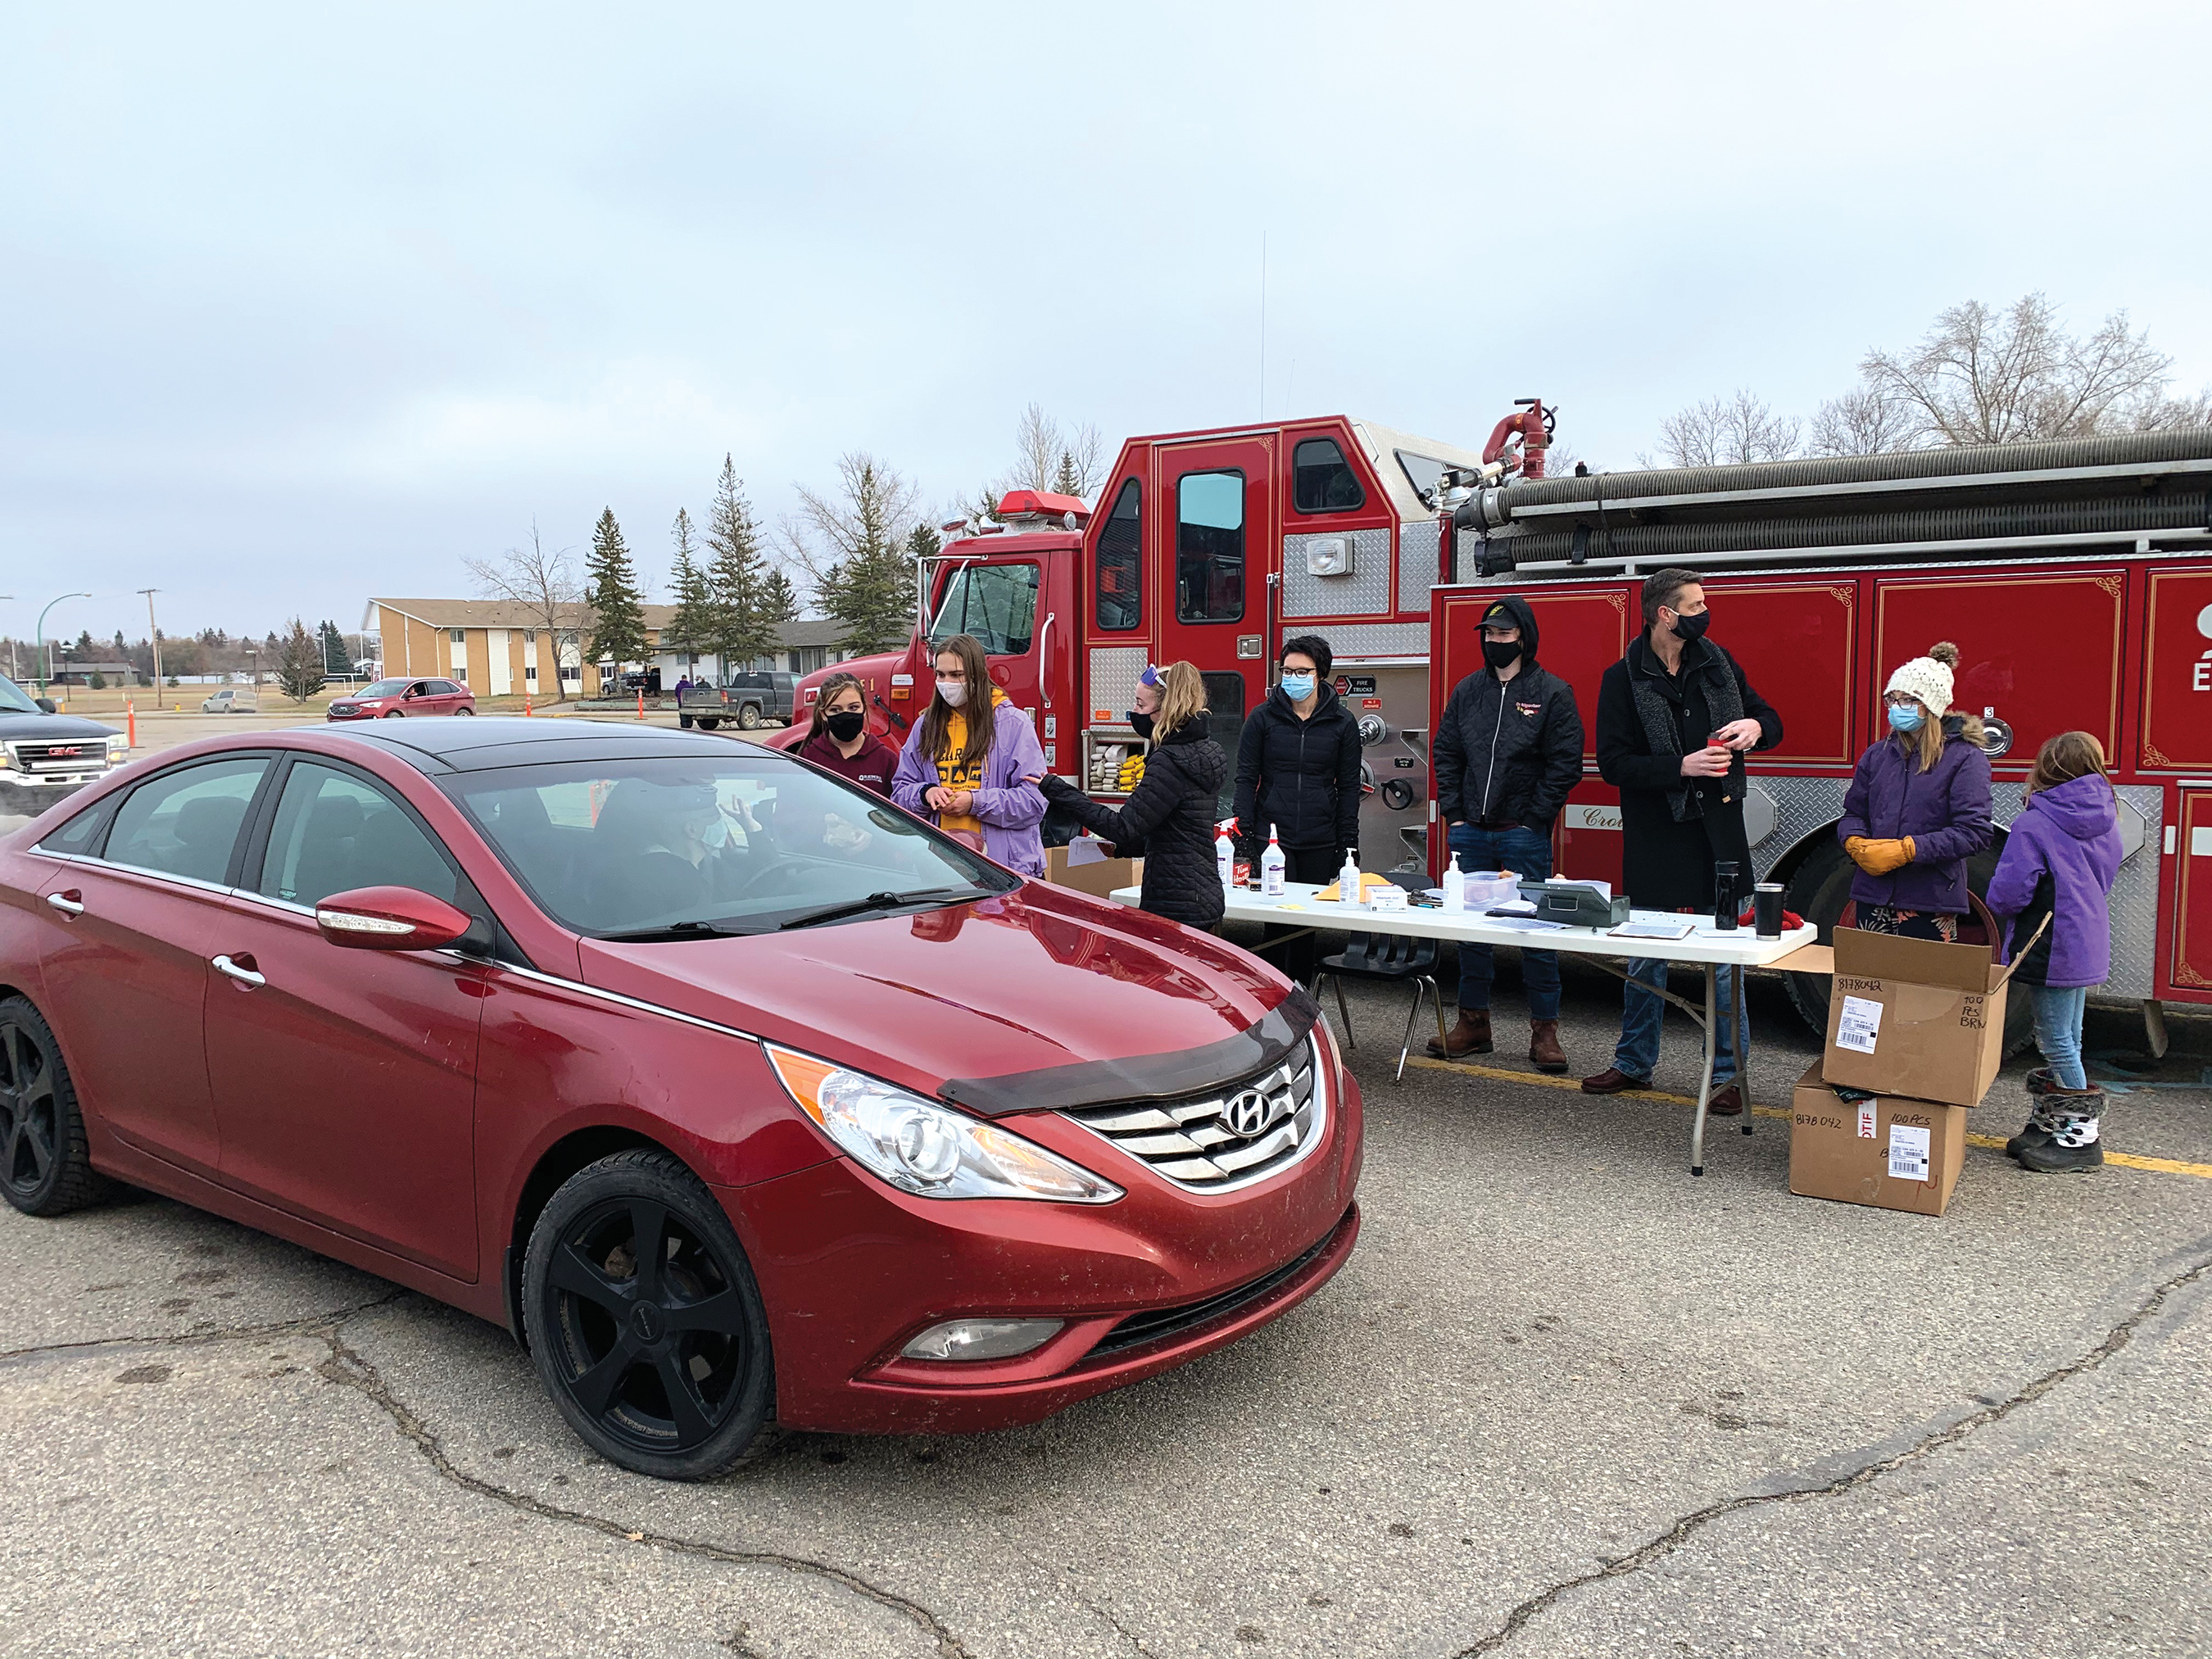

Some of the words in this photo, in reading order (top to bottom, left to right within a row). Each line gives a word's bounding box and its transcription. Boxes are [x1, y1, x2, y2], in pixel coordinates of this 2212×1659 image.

[2193, 662, 2212, 691] E
[869, 677, 875, 691] 1
[1986, 707, 1993, 717] 3
[48, 746, 82, 757] GMC
[1235, 863, 1249, 875] Tim
[1838, 977, 1883, 992] 8178042
[1964, 996, 1984, 1004] 100
[1960, 1016, 1988, 1030] BRN
[1891, 1113, 1910, 1123] 100
[1910, 1113, 1932, 1126] PCS
